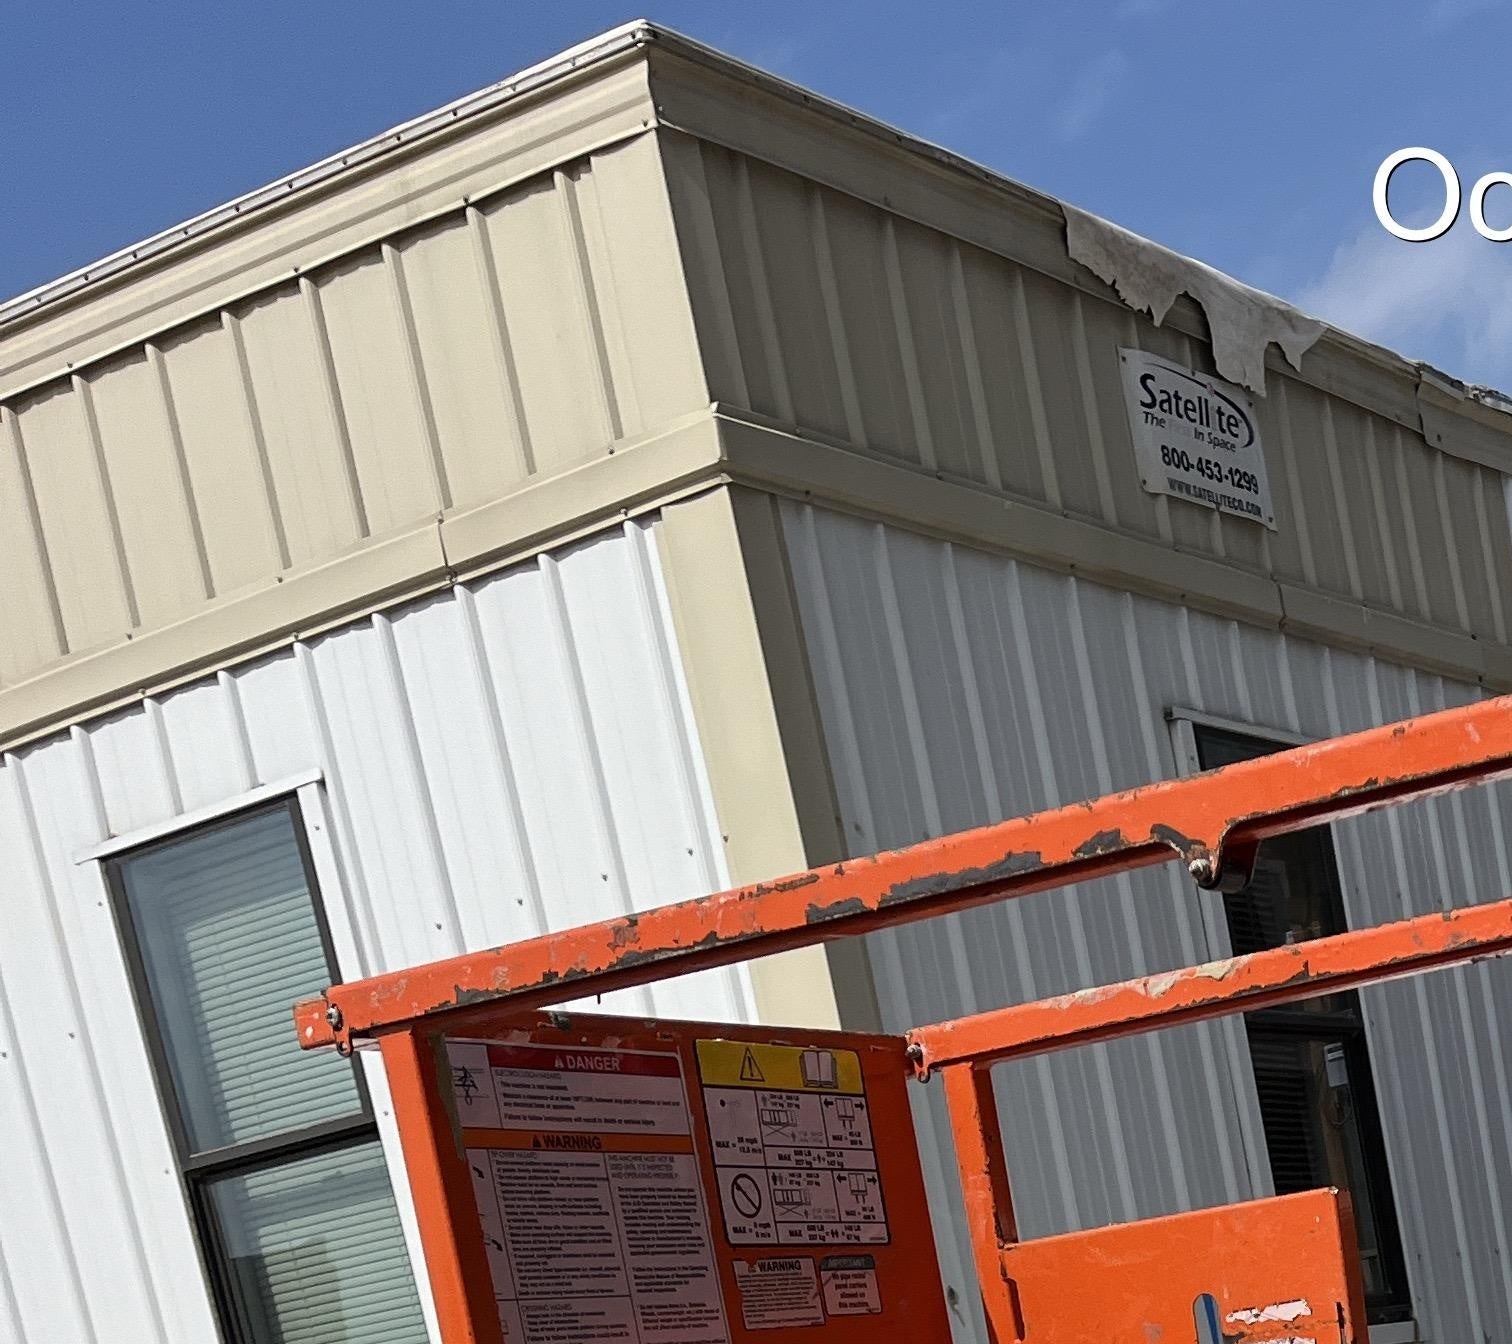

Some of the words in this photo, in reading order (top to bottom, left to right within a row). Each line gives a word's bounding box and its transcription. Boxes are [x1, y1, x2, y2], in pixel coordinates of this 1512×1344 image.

[1139, 373, 1239, 438] Satellte
[1143, 411, 1166, 428] The
[1207, 432, 1236, 453] Space
[1161, 445, 1258, 495] 800-453-1299
[567, 1055, 620, 1071] DANGER
[543, 1135, 602, 1150] WARNING
[758, 1260, 801, 1272] WARNING
